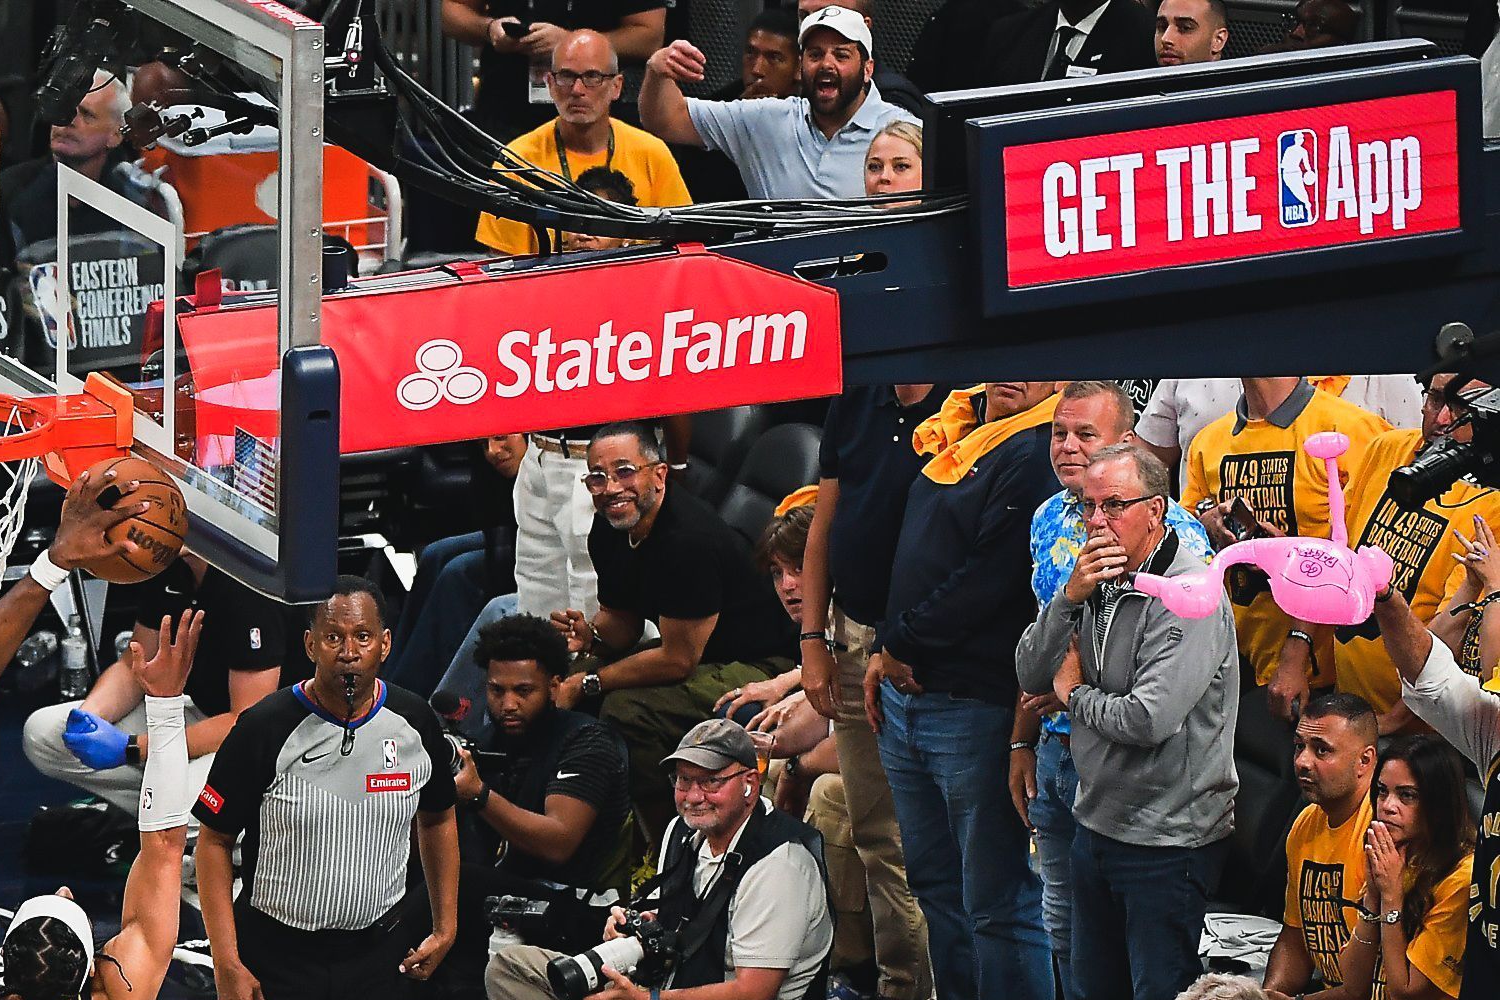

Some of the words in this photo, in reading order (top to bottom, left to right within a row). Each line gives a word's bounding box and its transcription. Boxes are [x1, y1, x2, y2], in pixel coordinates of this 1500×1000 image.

[1042, 152, 1144, 259] GET
[1155, 138, 1263, 242] THE
[1284, 204, 1305, 222] NBA
[1325, 125, 1423, 235] App
[71, 256, 138, 291] EASTERN
[76, 283, 165, 319] CONFERENC
[80, 316, 131, 348] FINALS
[1224, 461, 1239, 488] IN
[1239, 459, 1259, 487] 49
[1261, 457, 1289, 475] STATES
[1271, 473, 1287, 485] JUST
[1375, 498, 1399, 528] IN
[1393, 511, 1419, 537] 49
[370, 777, 408, 789] Emirates
